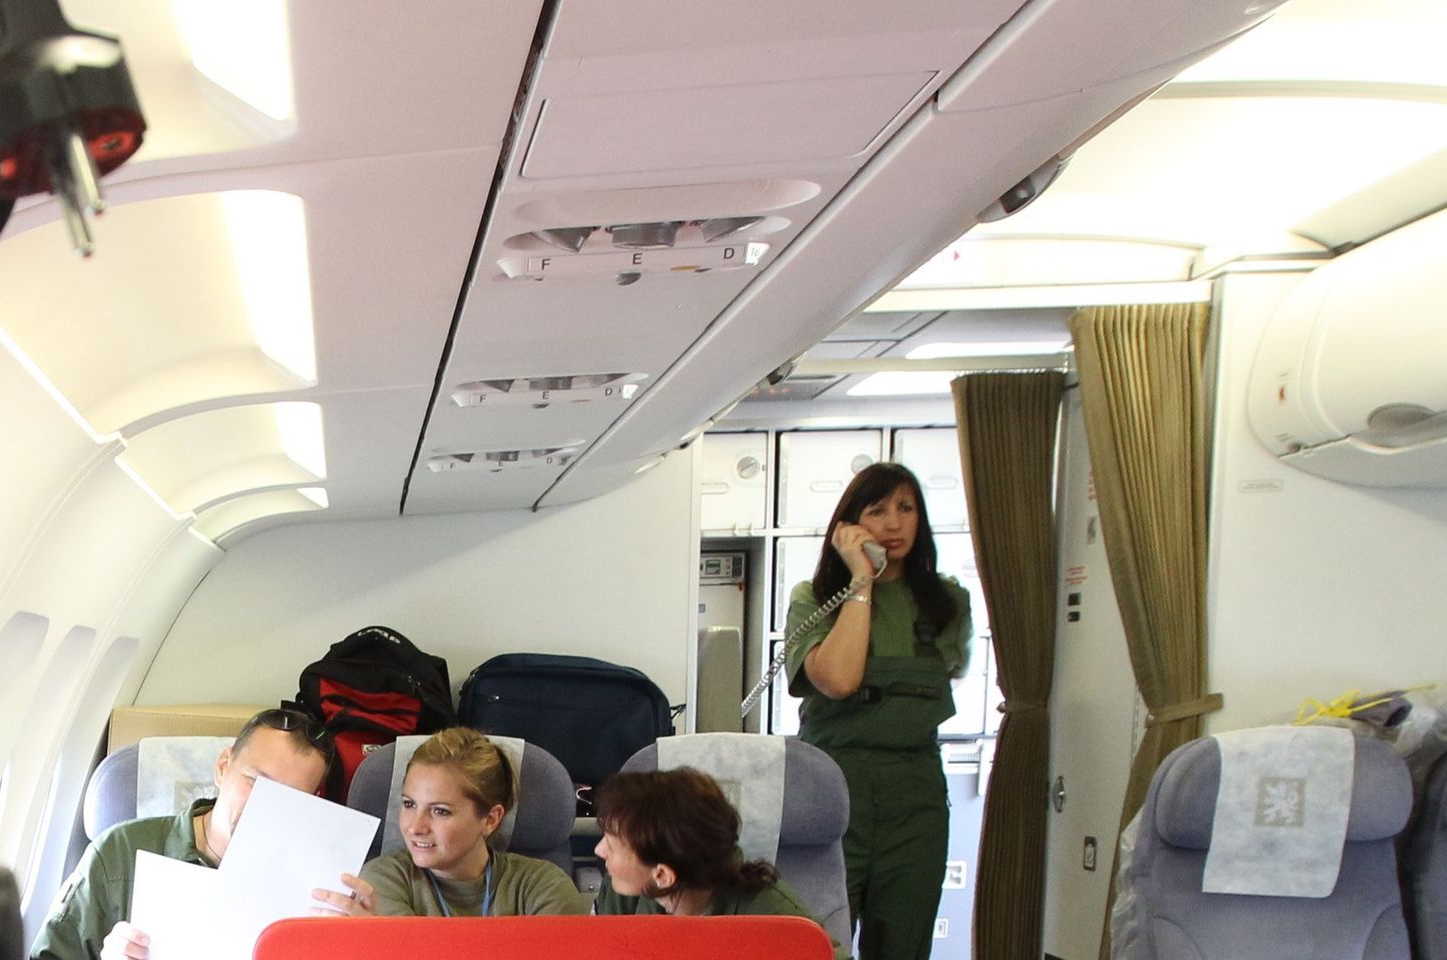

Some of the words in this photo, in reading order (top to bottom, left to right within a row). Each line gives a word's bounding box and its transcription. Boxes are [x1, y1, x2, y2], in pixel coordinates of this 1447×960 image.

[540, 258, 551, 271] F
[632, 252, 643, 265] E
[723, 247, 735, 260] D
[479, 394, 487, 403] F
[542, 390, 550, 400] E
[604, 387, 613, 396] D
